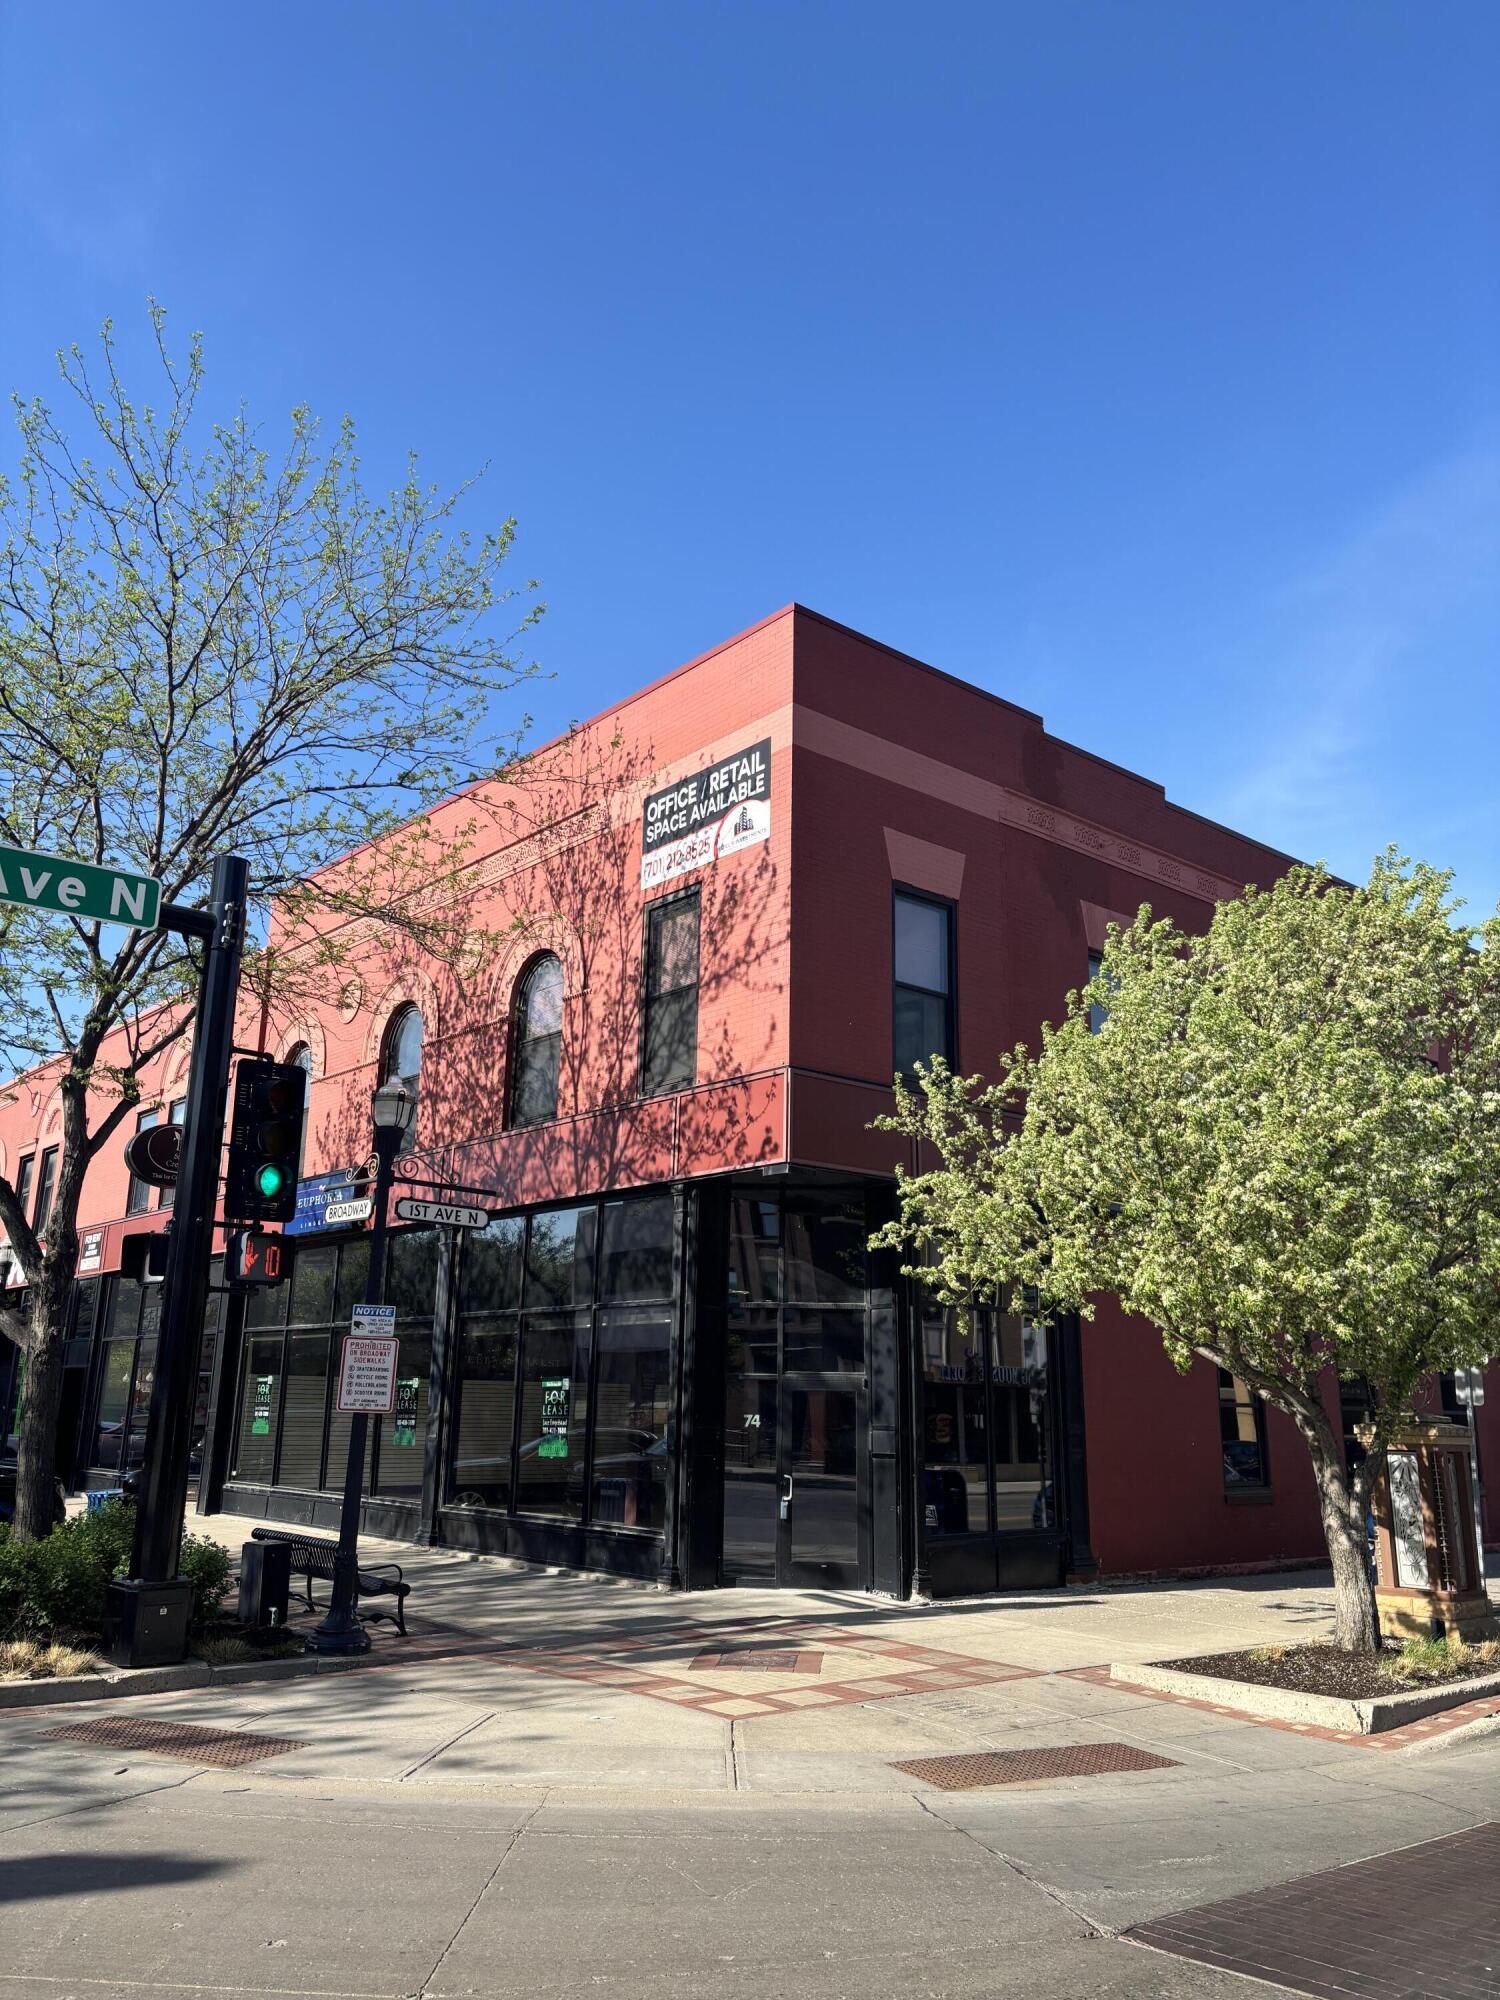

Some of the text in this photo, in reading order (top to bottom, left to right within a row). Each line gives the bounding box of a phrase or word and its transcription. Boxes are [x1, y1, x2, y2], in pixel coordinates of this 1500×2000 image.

[647, 782, 698, 823] OFFICE
[709, 751, 766, 795] RETAIL
[646, 773, 765, 843] SPACE AVAILABLE
[0, 863, 147, 921] ve N
[328, 1202, 369, 1219] BROADWAY
[409, 1204, 479, 1224] 1ST AVE N
[355, 1307, 393, 1316] NOTICE
[350, 1341, 392, 1351] PROHIBITED
[359, 1350, 391, 1358] BROADWAY
[353, 1357, 386, 1365] SIDEWALKS
[257, 1384, 270, 1395] FOR
[399, 1388, 416, 1400] FOR
[255, 1395, 271, 1403] LEASE
[544, 1390, 566, 1405] FOR
[397, 1400, 417, 1410] LEASE
[542, 1404, 569, 1416] LEASE
[743, 1413, 761, 1428] 74
